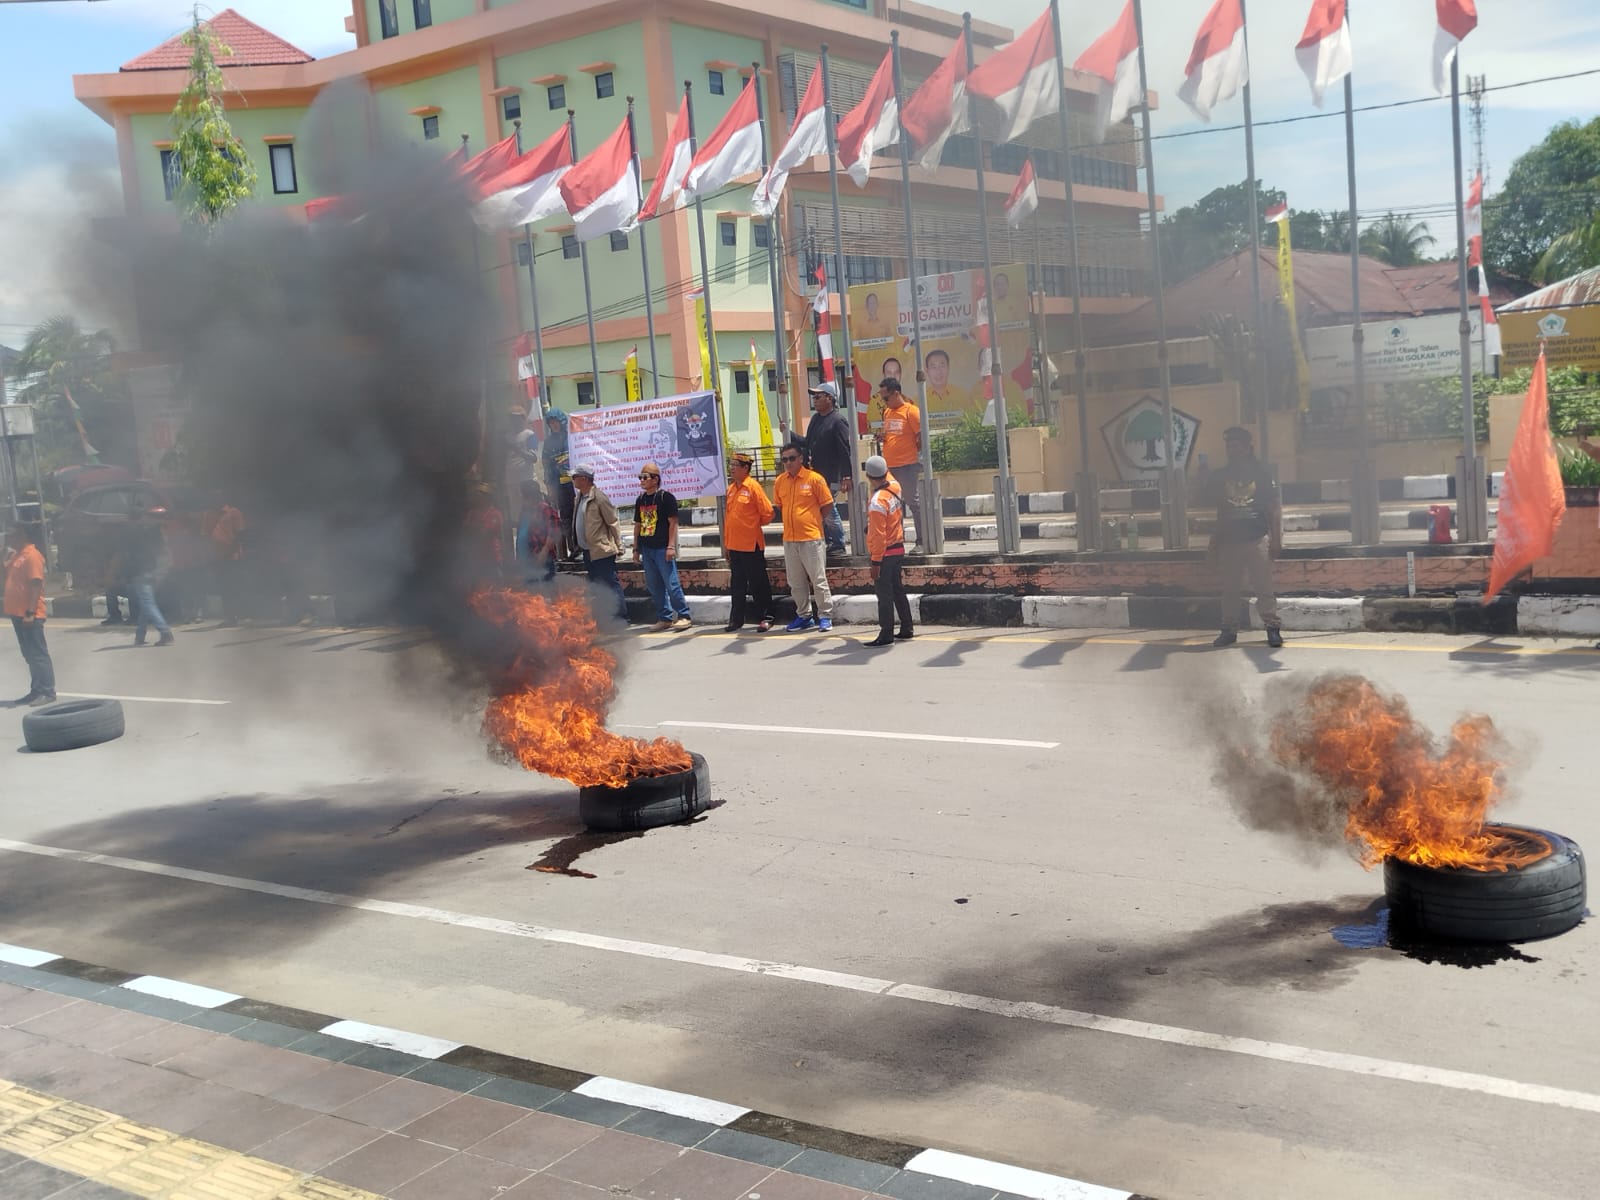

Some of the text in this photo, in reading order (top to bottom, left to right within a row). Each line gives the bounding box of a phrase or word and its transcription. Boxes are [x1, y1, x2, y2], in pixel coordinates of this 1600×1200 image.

[611, 406, 643, 417] TUNTUTAN
[643, 400, 690, 411] REVOLUSIONER
[604, 410, 678, 427] PARTAI BURUH KALTARA
